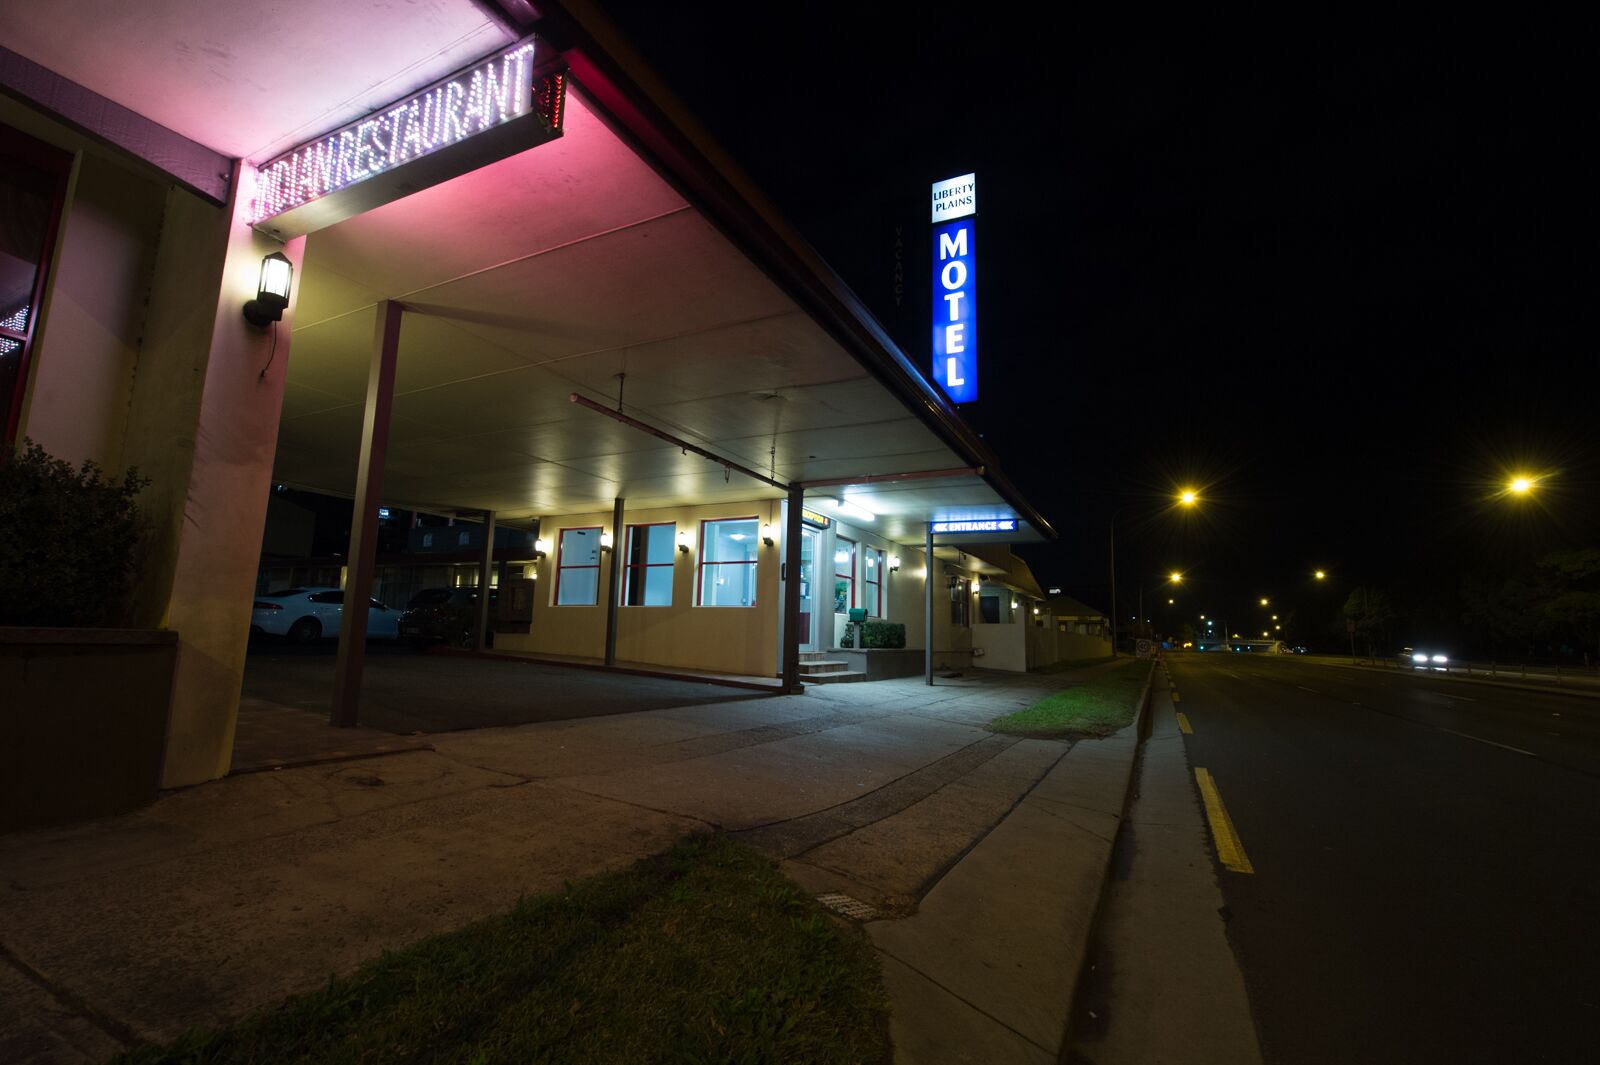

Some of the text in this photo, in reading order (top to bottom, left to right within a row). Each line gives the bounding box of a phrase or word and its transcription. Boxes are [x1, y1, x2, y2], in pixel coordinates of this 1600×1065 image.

[933, 183, 974, 201] LIBERTY
[935, 196, 973, 212] PLAINS
[894, 226, 904, 307] VACANCY
[940, 228, 968, 388] MOTEL
[949, 521, 997, 531] ENTRANCE
